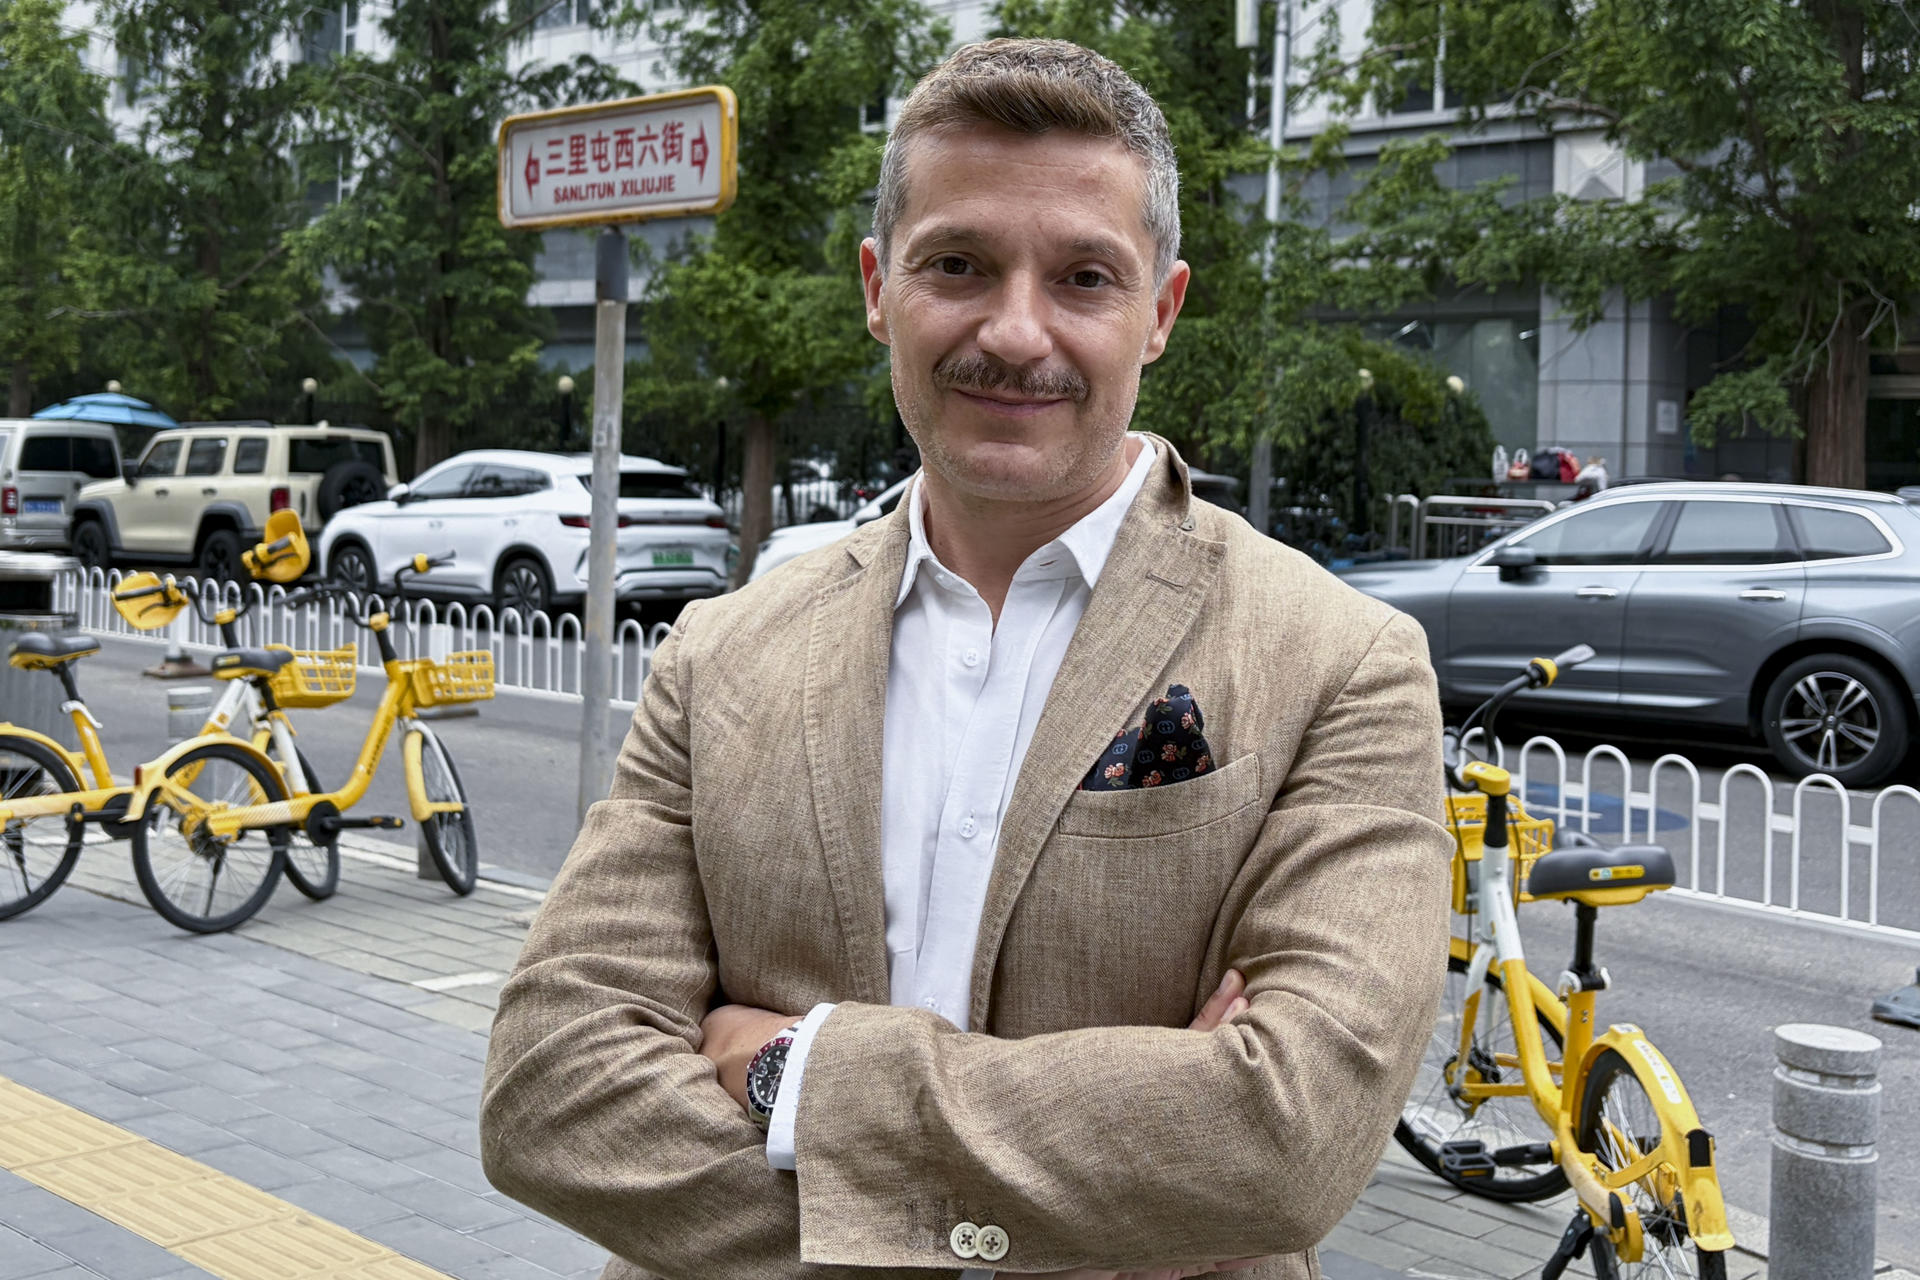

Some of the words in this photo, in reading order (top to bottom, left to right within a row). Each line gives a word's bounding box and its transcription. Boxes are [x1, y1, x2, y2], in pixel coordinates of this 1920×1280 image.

[546, 121, 684, 176] 三里屯西六街
[554, 181, 615, 204] SANLITUN
[621, 175, 675, 197] XILIUJIE
